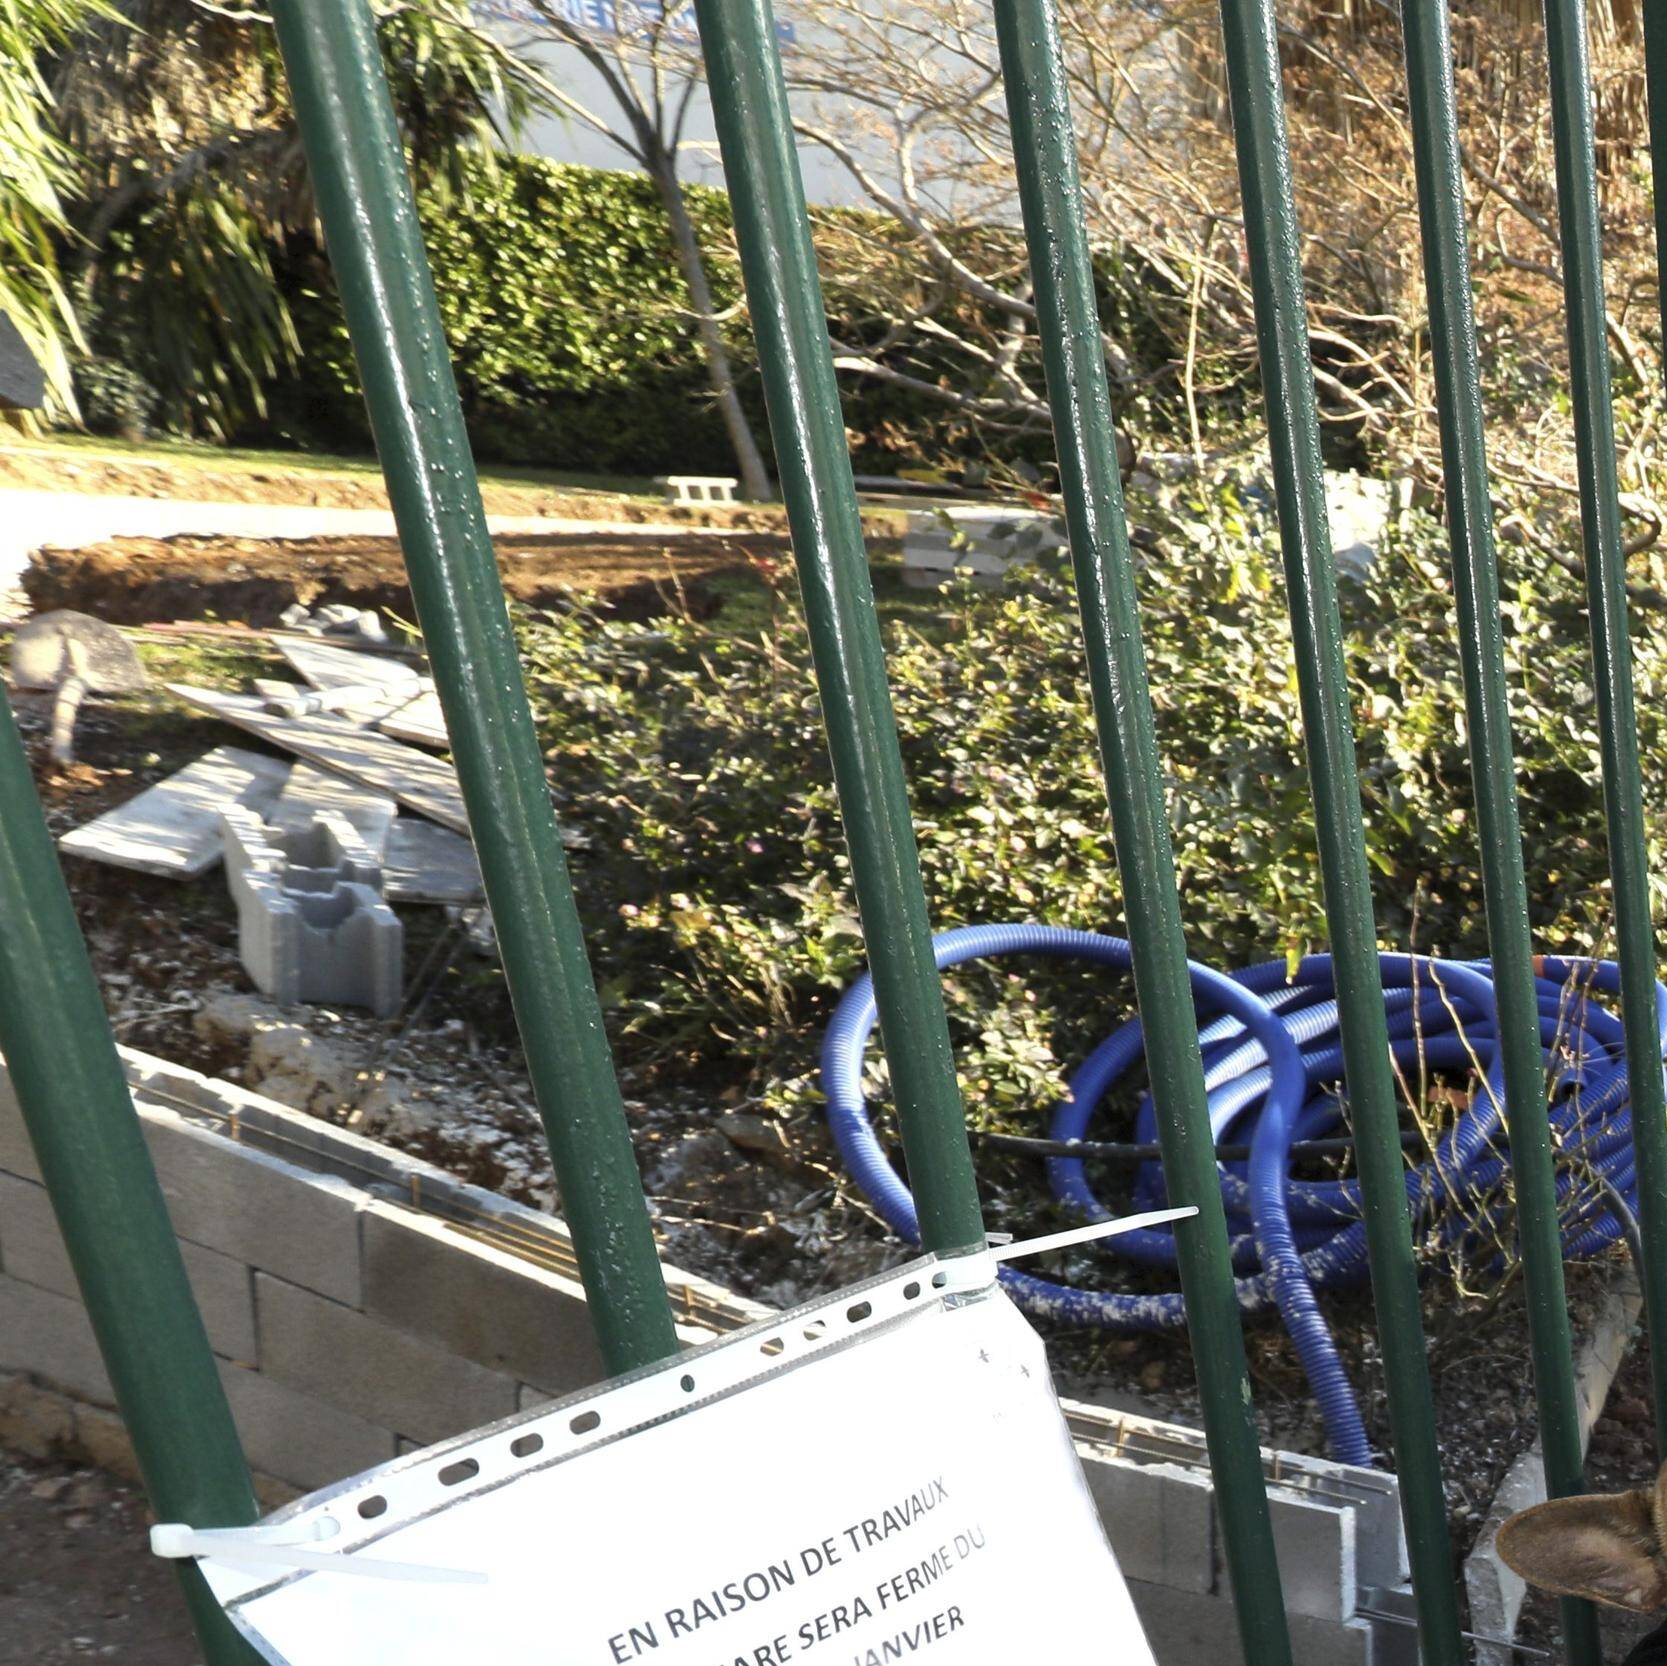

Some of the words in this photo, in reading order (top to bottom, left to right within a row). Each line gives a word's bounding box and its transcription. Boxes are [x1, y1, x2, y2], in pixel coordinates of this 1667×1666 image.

[608, 1621, 659, 1665] EN
[664, 1559, 795, 1638] RAISON
[799, 1537, 842, 1577] DE
[842, 1480, 949, 1553] TRAVAUX
[798, 1596, 873, 1650] SERA
[876, 1545, 953, 1610] FERME
[953, 1529, 985, 1560] DU
